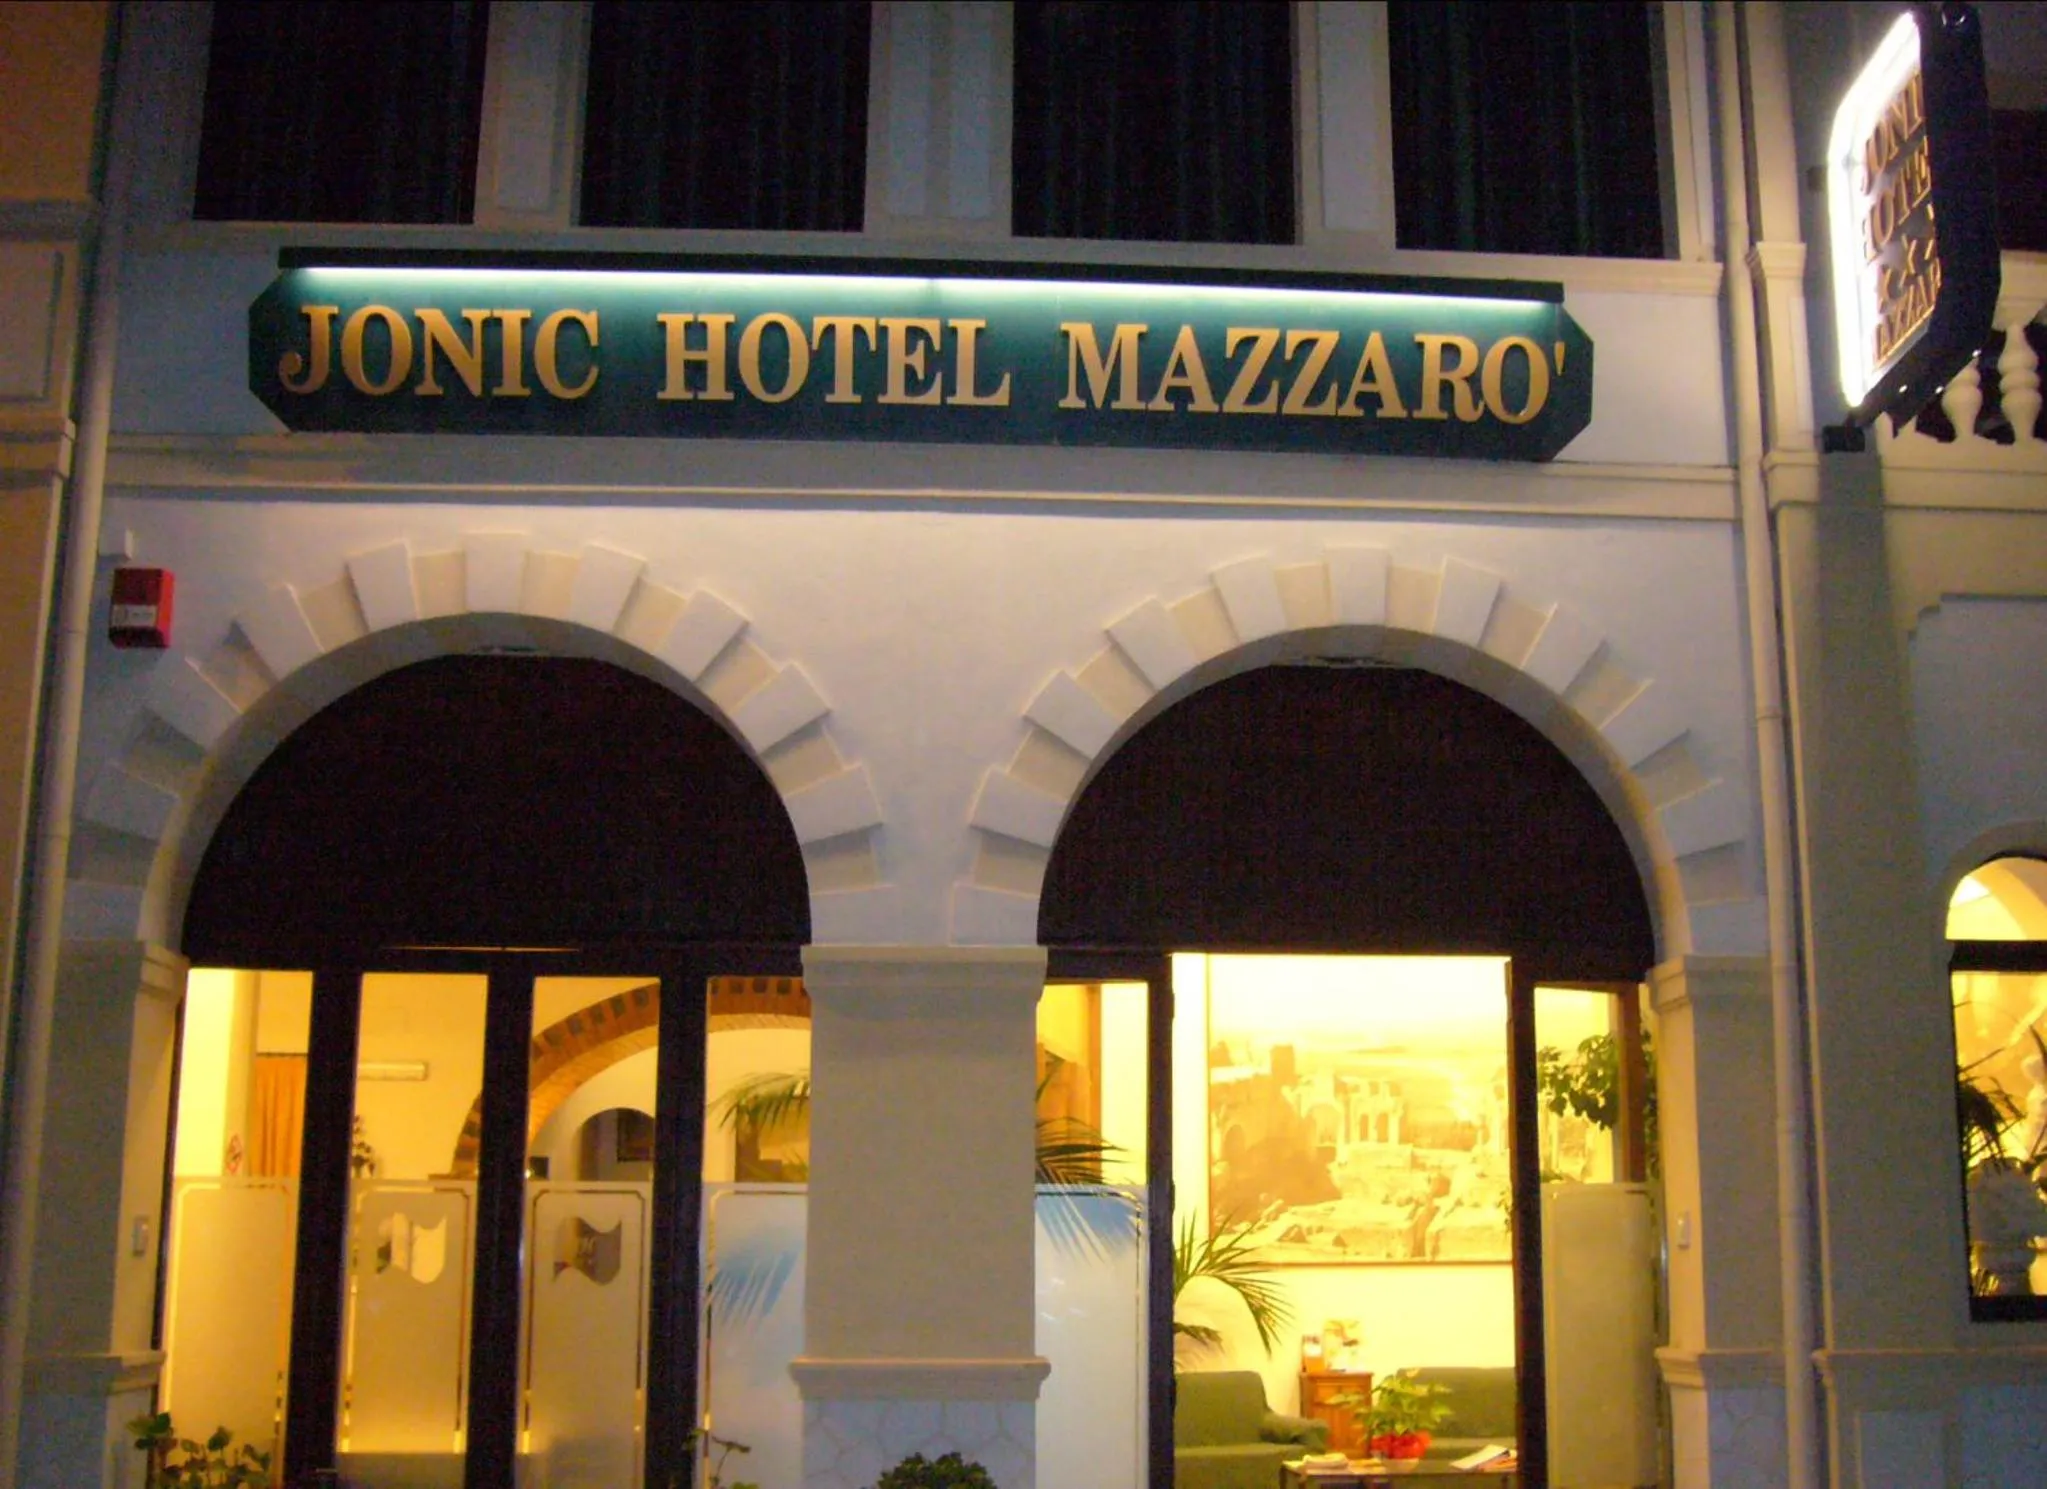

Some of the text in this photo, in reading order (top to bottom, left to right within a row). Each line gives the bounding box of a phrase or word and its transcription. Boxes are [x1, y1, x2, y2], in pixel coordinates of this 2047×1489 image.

[1860, 73, 1925, 195] JONI
[279, 304, 1567, 425] JONIC HOTEL MAZZARO'
